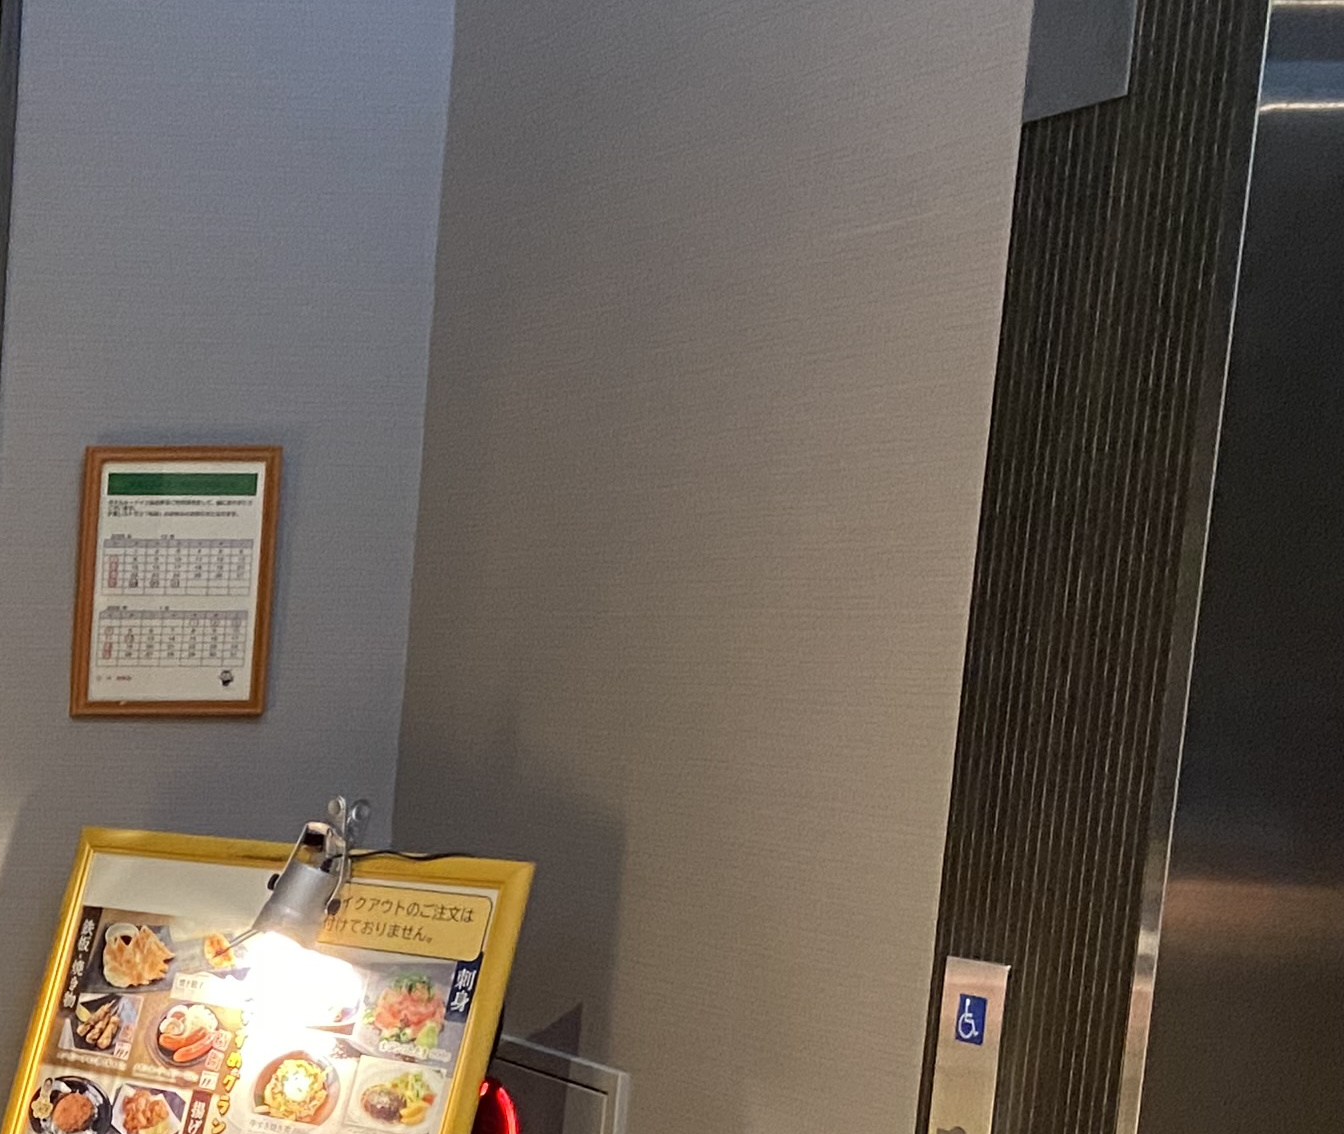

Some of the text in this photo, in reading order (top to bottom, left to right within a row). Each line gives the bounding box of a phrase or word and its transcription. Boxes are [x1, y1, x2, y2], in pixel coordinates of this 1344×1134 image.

[341, 897, 476, 924] イクアウトのご注文は
[449, 968, 478, 1012] 刺身
